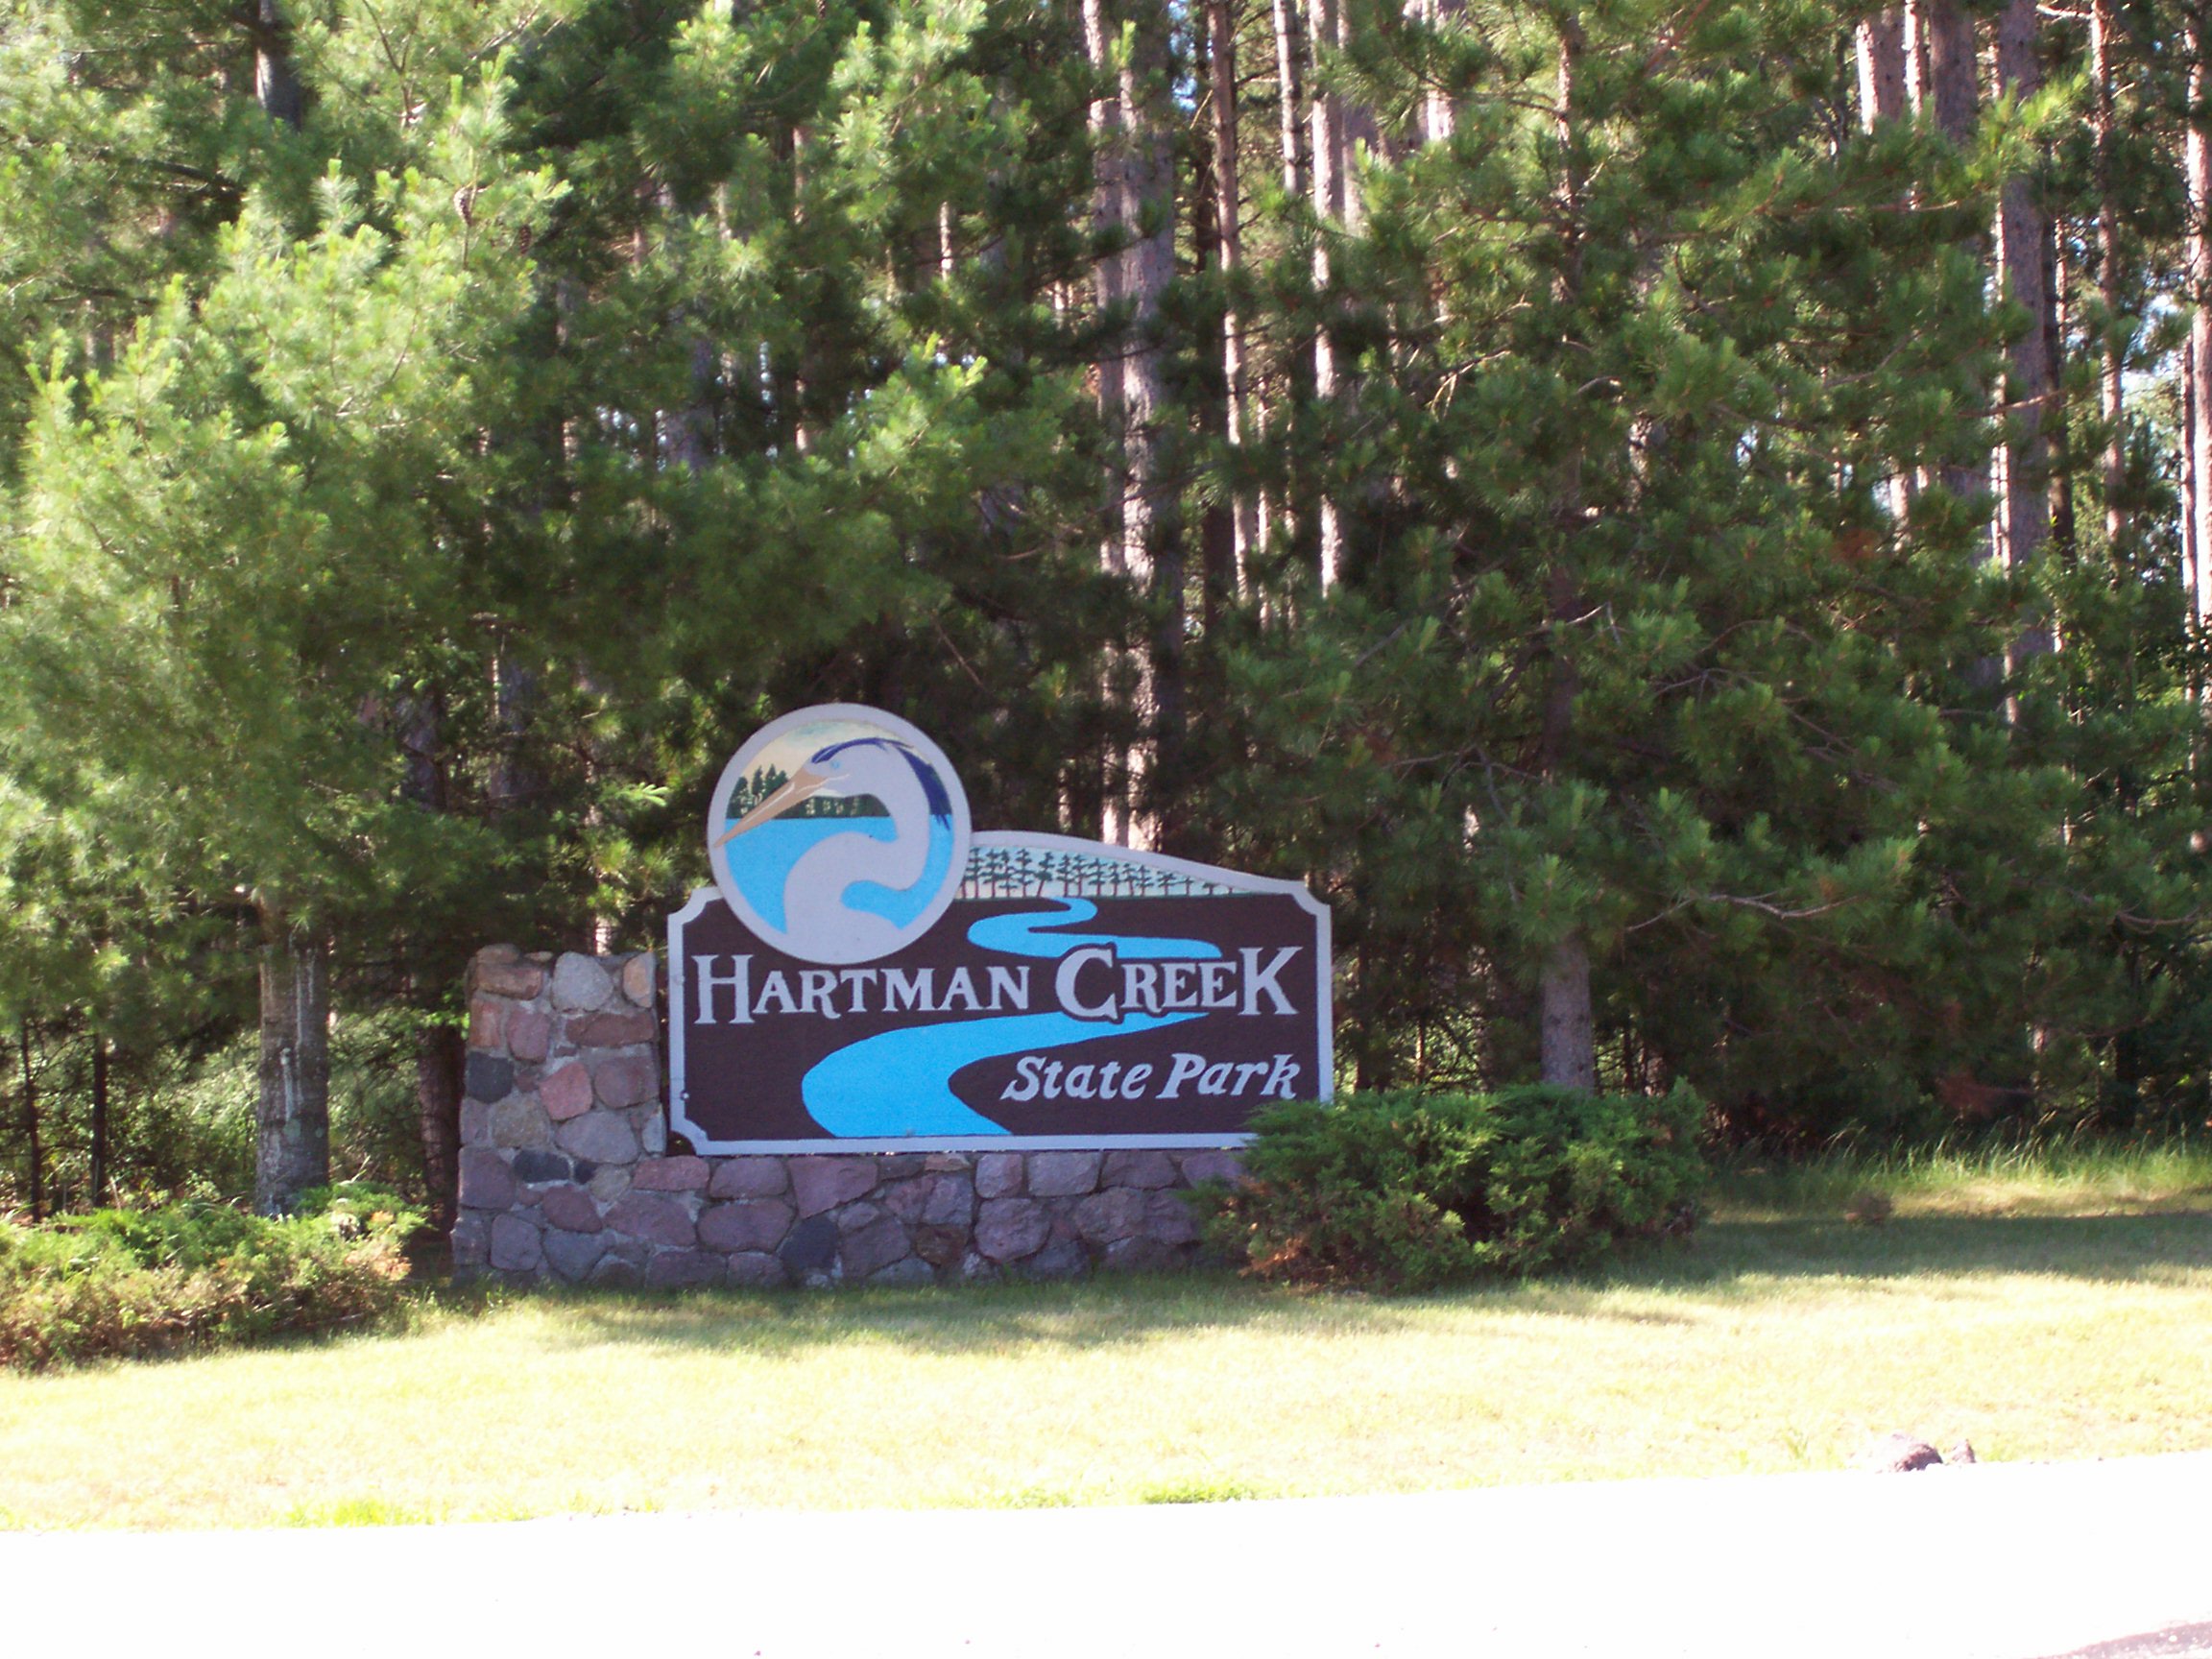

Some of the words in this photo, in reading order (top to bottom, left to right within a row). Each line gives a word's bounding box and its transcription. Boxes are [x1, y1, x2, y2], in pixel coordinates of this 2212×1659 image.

[692, 954, 1030, 1024] HARTMAN
[1055, 946, 1304, 1021] CREEK
[999, 1056, 1153, 1101] State
[1156, 1052, 1302, 1100] Park
